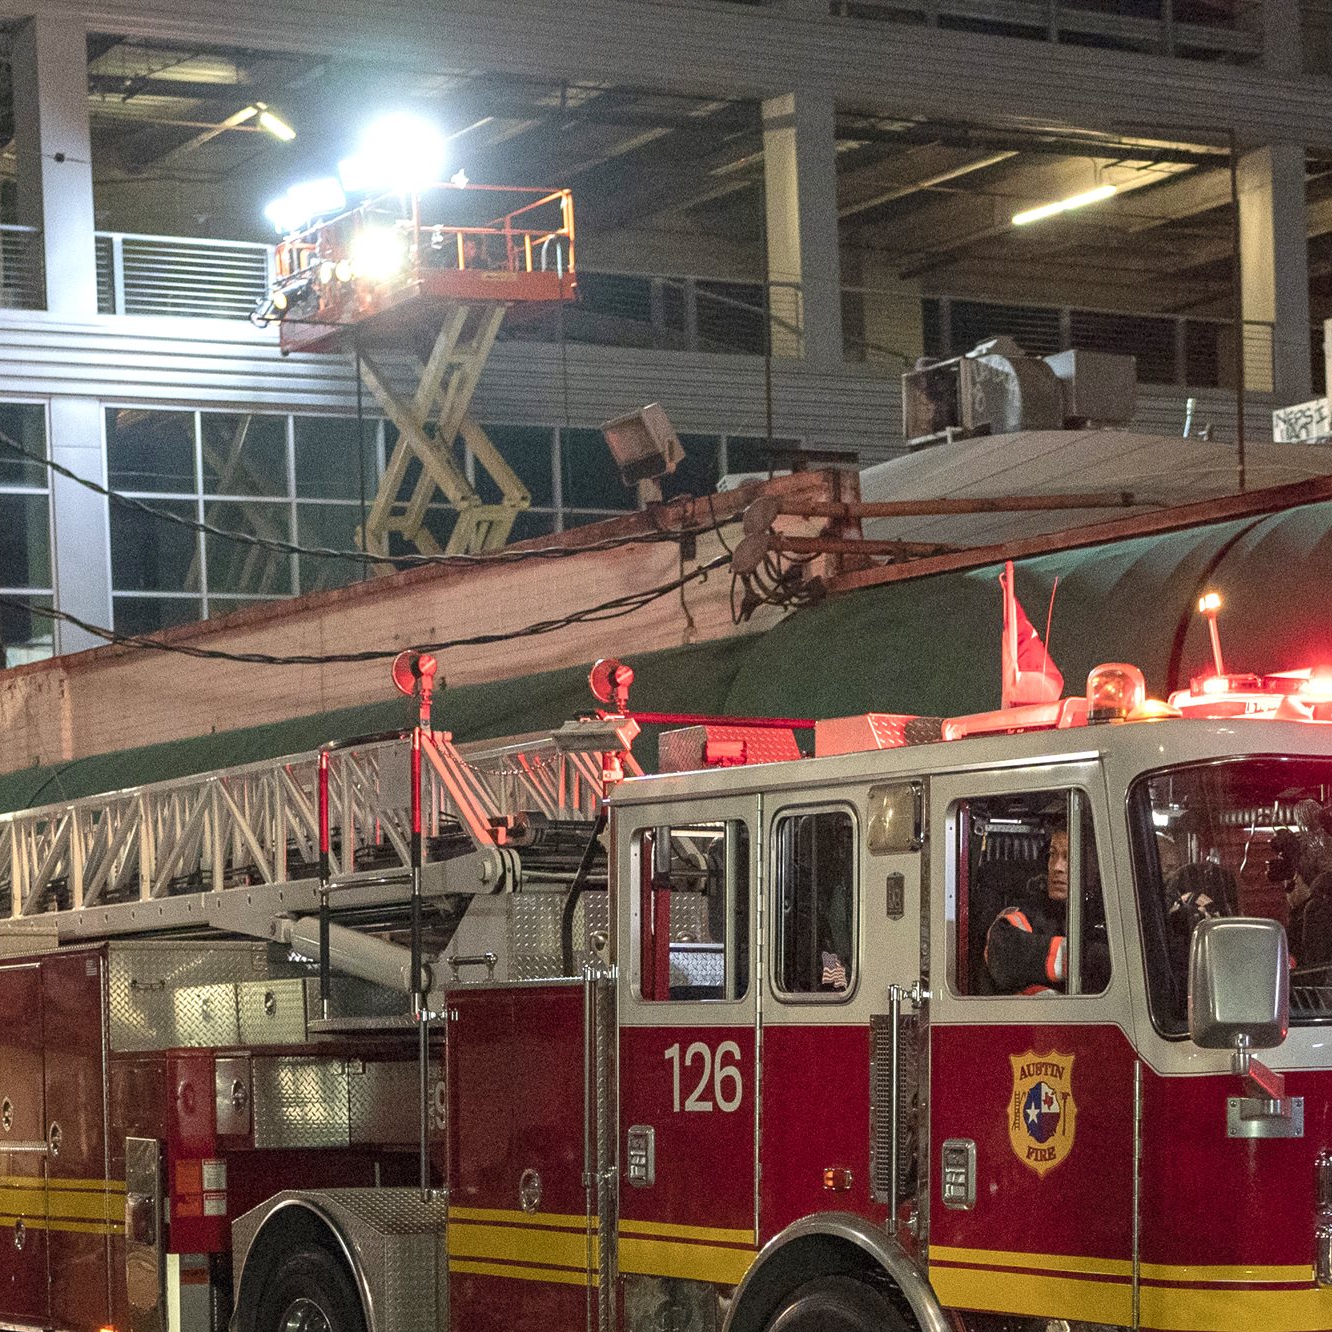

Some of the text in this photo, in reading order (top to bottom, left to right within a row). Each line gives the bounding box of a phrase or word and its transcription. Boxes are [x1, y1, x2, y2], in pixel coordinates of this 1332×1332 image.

[664, 1041, 743, 1113] 126
[1019, 1062, 1065, 1081] AUSTIN
[1026, 1146, 1056, 1162] FIRE
